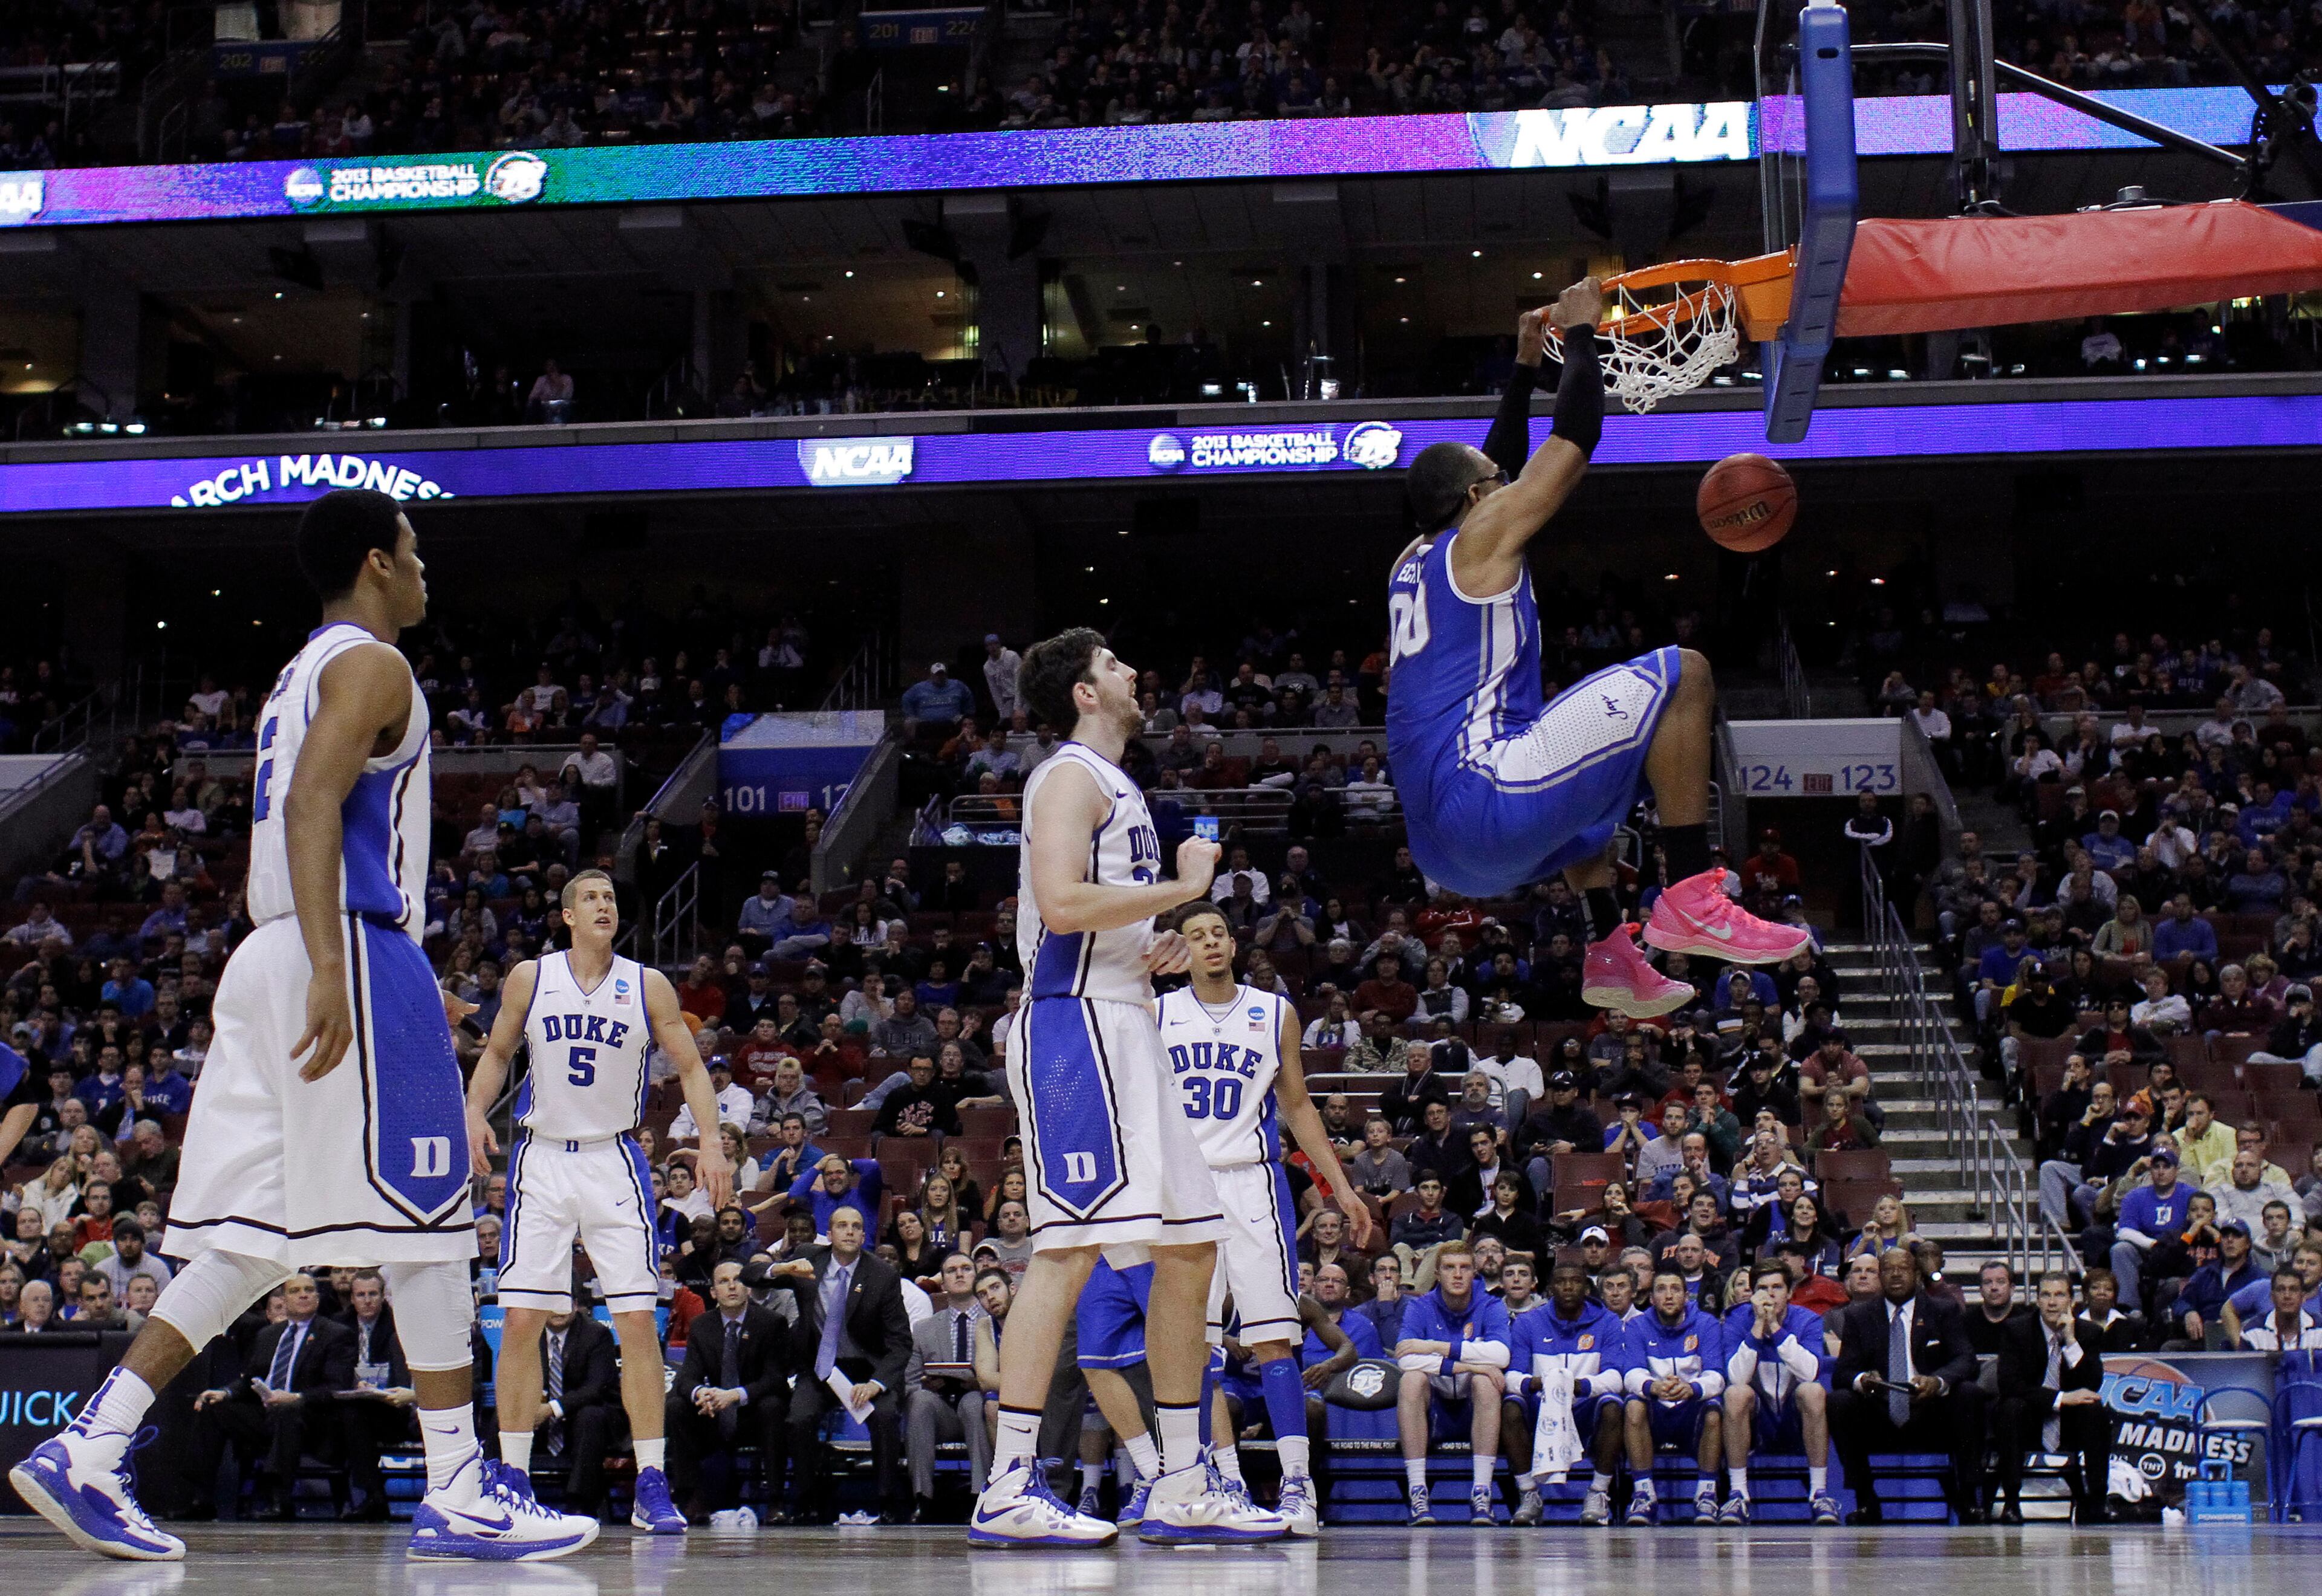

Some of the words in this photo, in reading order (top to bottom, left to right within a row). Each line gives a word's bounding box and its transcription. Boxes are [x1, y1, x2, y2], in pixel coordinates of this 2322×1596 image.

[1511, 102, 1749, 168] NCAA
[330, 168, 369, 184] 2013
[371, 164, 480, 183] BASKETBALL
[330, 179, 480, 201] CHAMPIONSHIP
[1191, 435, 1228, 450] 2013
[1230, 432, 1337, 448] BASKETBALL
[811, 445, 912, 478] NCAA
[1191, 446, 1338, 467] CHAMPIONSHIP
[1741, 765, 1793, 791] 124
[1842, 764, 1896, 791] 123
[724, 786, 766, 812] 101
[542, 1014, 629, 1049] DUKE
[568, 1046, 596, 1087] 5
[1168, 1042, 1263, 1079] DUKE
[1183, 1076, 1243, 1120] 30
[410, 1136, 451, 1178] D
[565, 1139, 579, 1152] D
[1062, 1151, 1097, 1184] D
